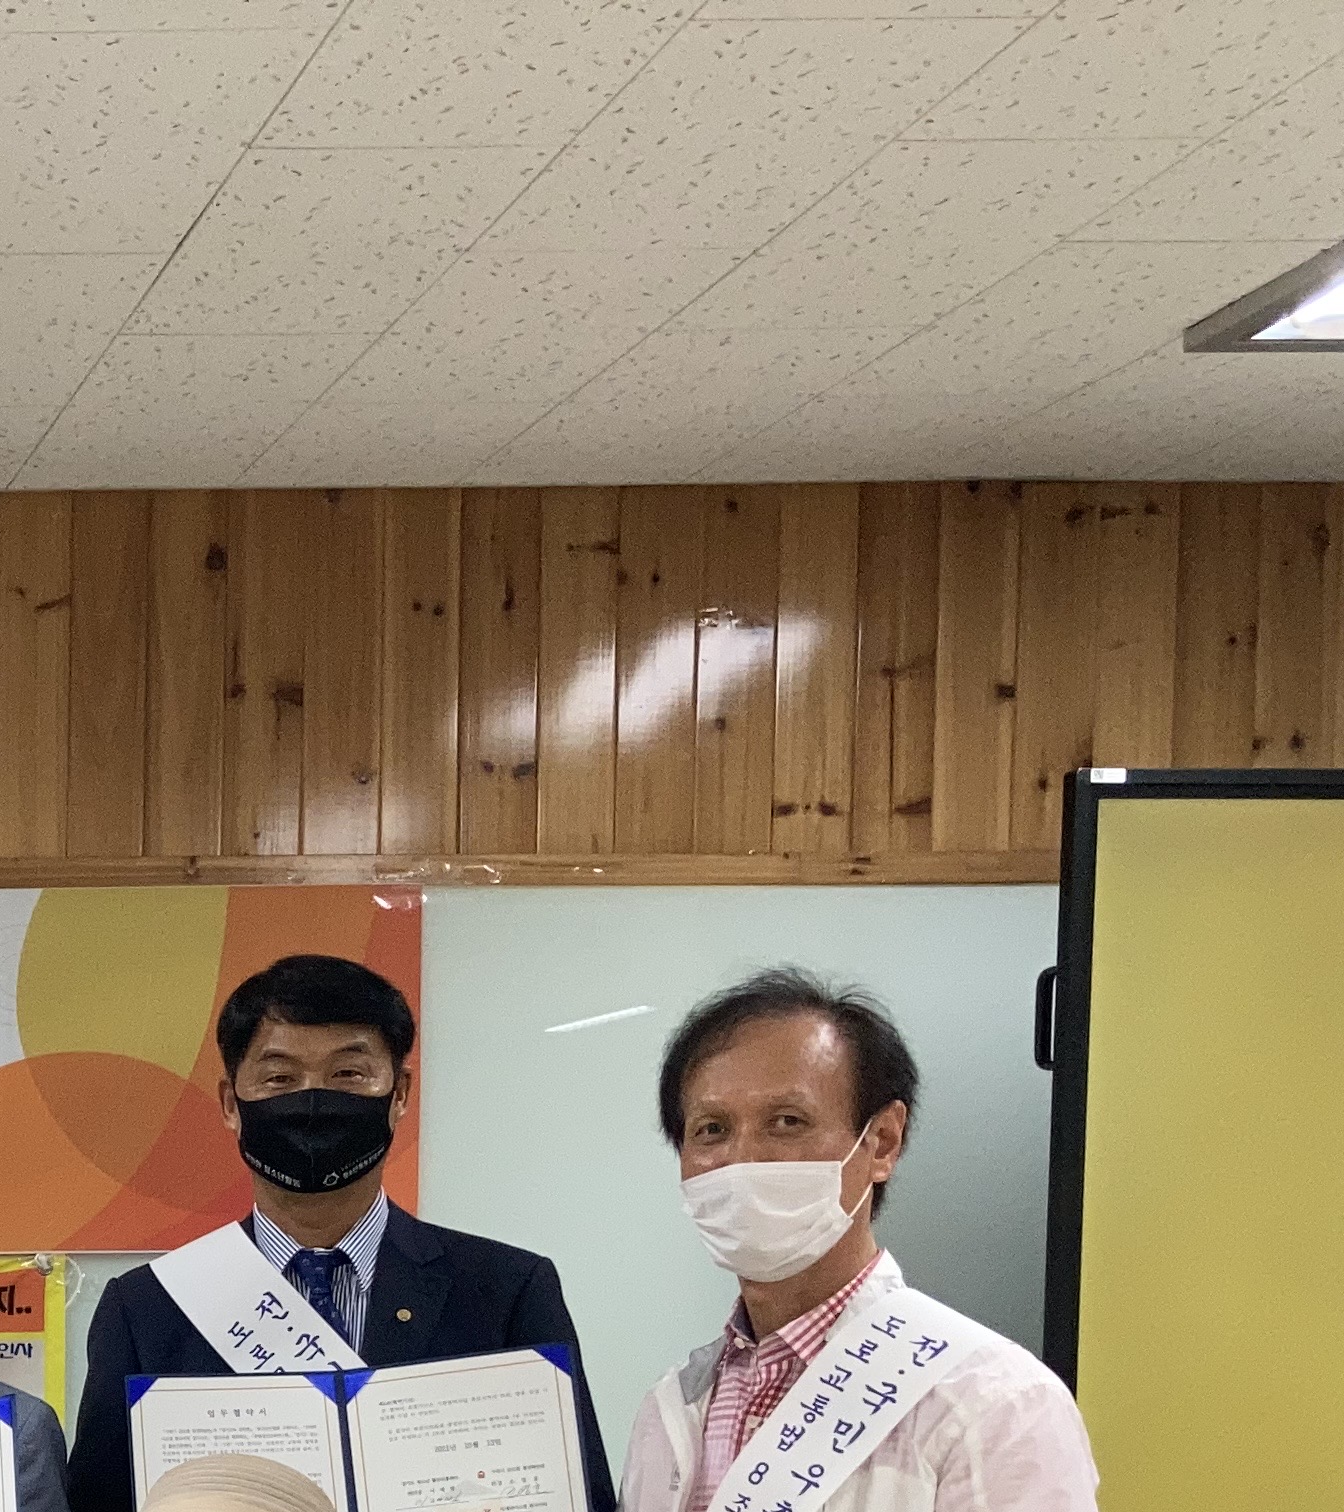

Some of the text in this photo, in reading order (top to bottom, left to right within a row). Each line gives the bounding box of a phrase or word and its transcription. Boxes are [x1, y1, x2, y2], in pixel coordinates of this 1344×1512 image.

[228, 1321, 285, 1373] 도로
[255, 1291, 343, 1370] 전·국
[777, 1315, 907, 1453] 도로교통법
